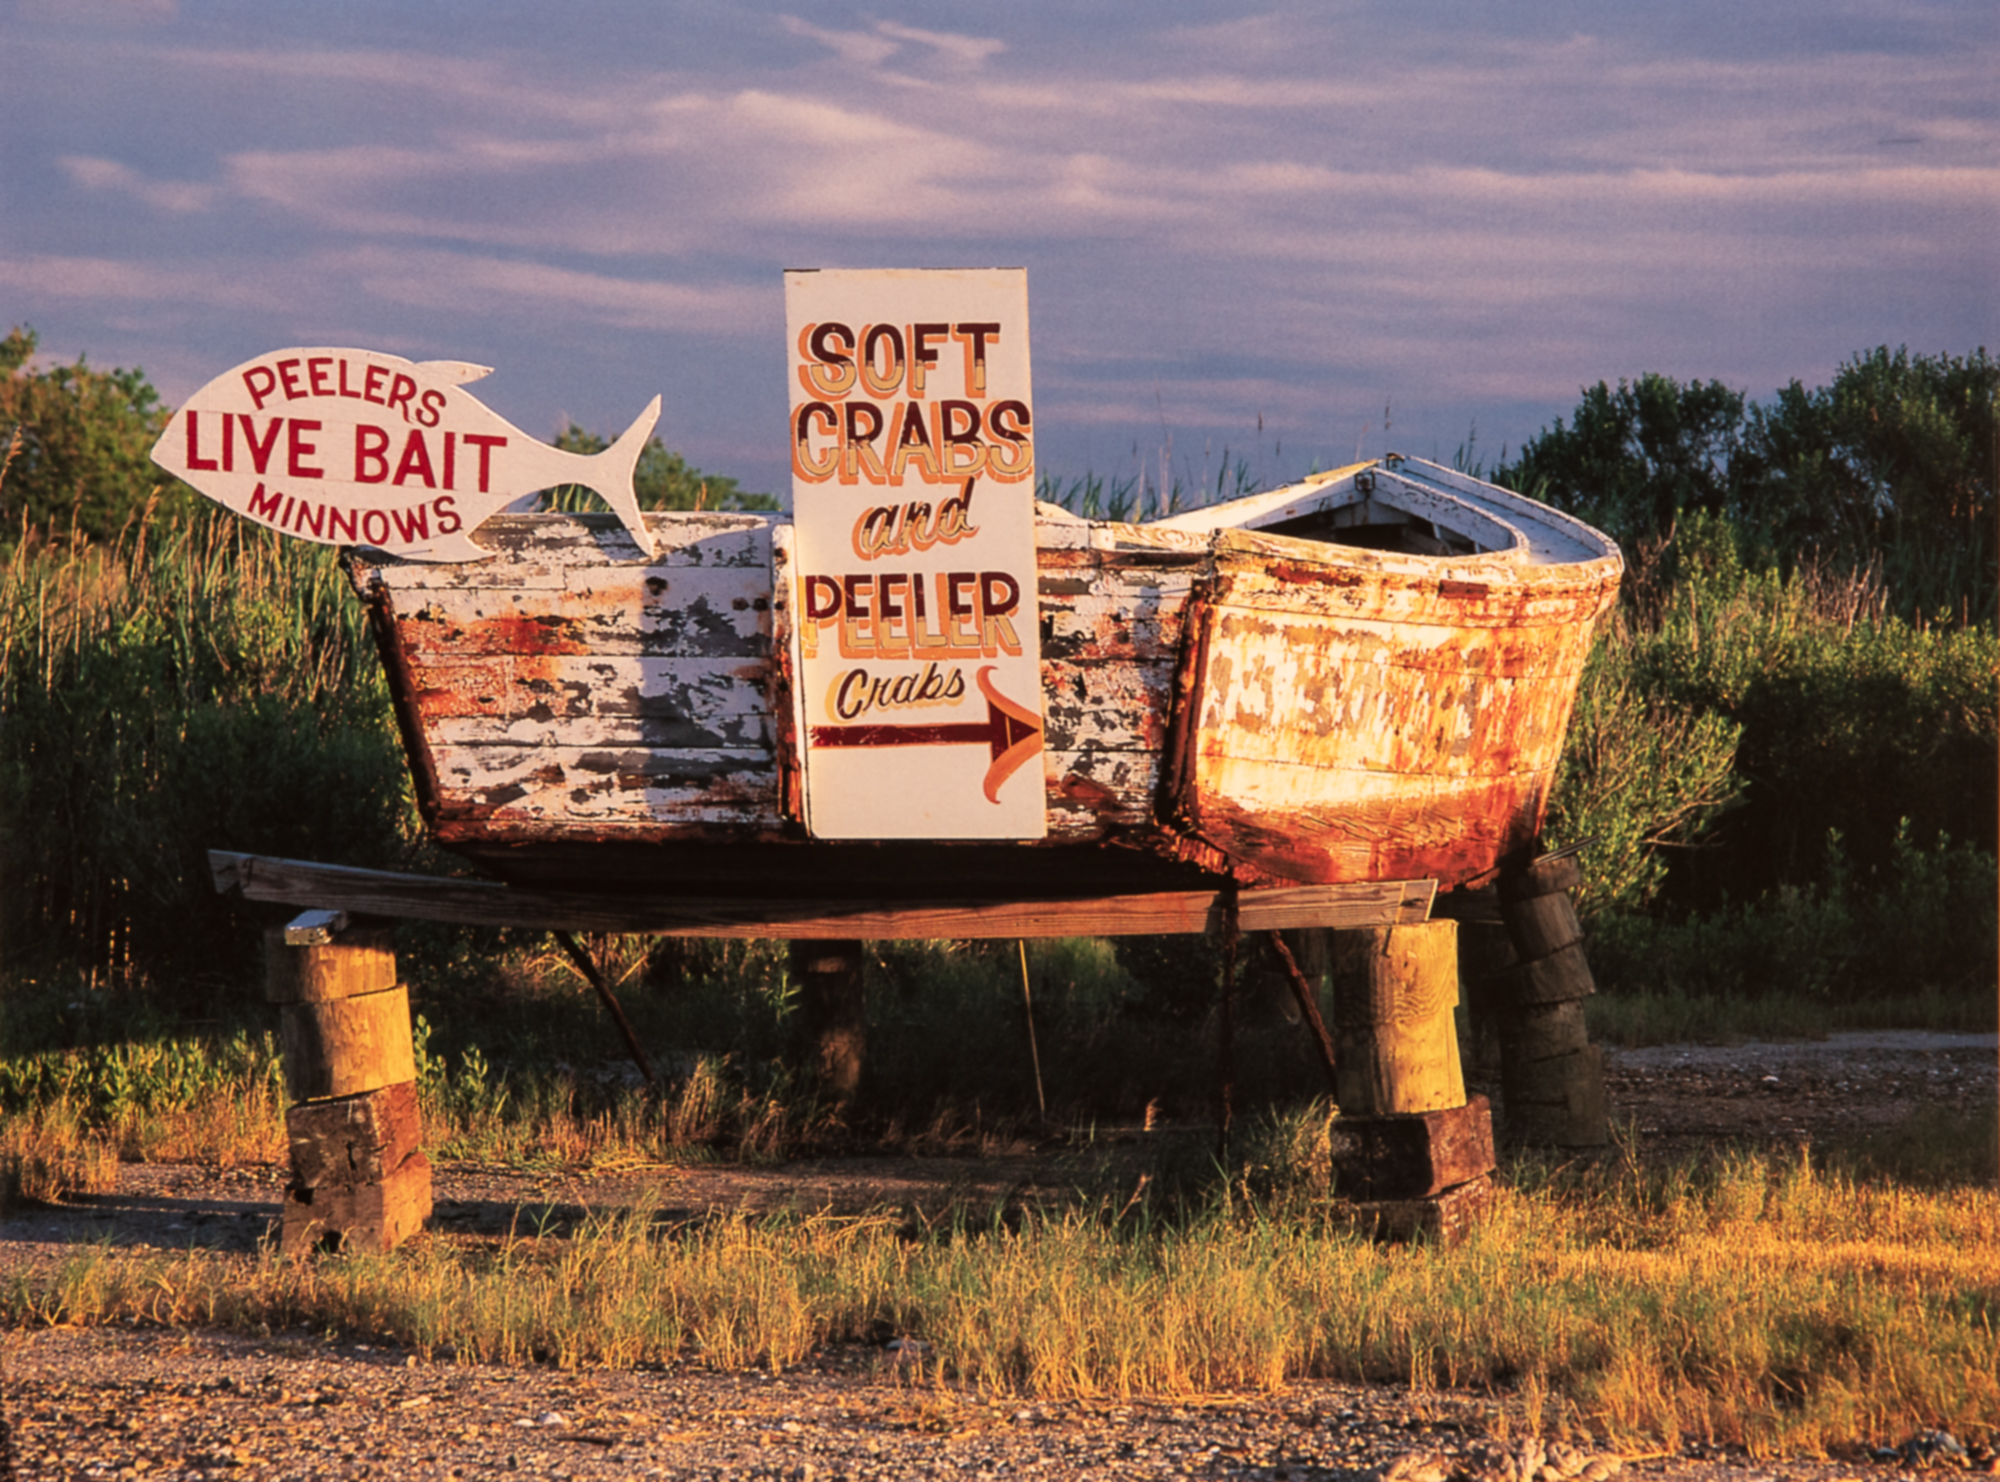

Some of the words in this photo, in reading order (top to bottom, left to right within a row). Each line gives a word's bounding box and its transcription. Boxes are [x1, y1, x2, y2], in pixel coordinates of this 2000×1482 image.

[242, 357, 447, 427] PEELERS
[798, 322, 1000, 400] SOFT
[186, 410, 324, 478] LIVE
[355, 424, 507, 492] BAIT
[790, 400, 1032, 486] CRABS
[247, 482, 462, 545] MINNOWS
[852, 476, 979, 560] and
[798, 572, 1022, 660] PEELER
[825, 662, 965, 724] Crabs
